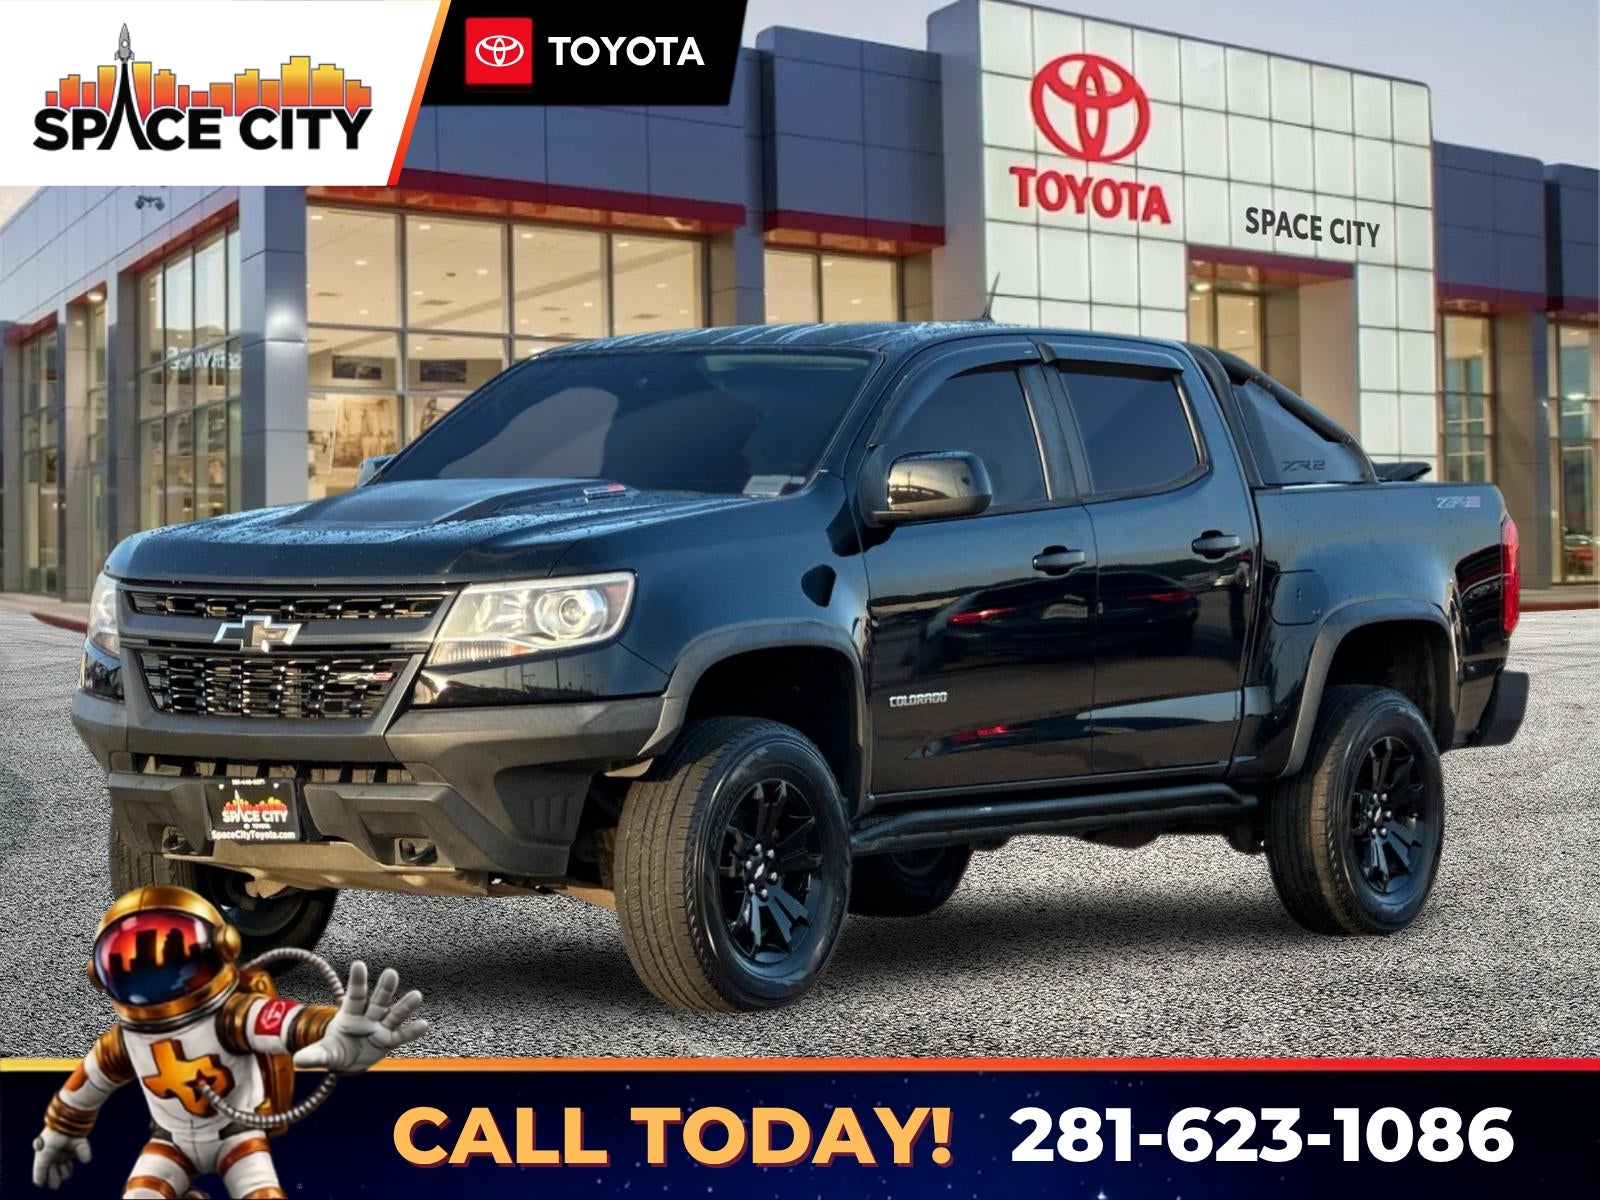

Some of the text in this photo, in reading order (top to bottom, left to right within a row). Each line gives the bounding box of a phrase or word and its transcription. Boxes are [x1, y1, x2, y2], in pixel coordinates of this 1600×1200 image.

[1009, 166, 1171, 224] TOYOTA
[1246, 206, 1380, 248] SPACE CITY
[889, 691, 948, 708] COLORADO
[222, 810, 288, 823] SPACE CITY
[211, 830, 296, 841] SpaceCityToyota.com
